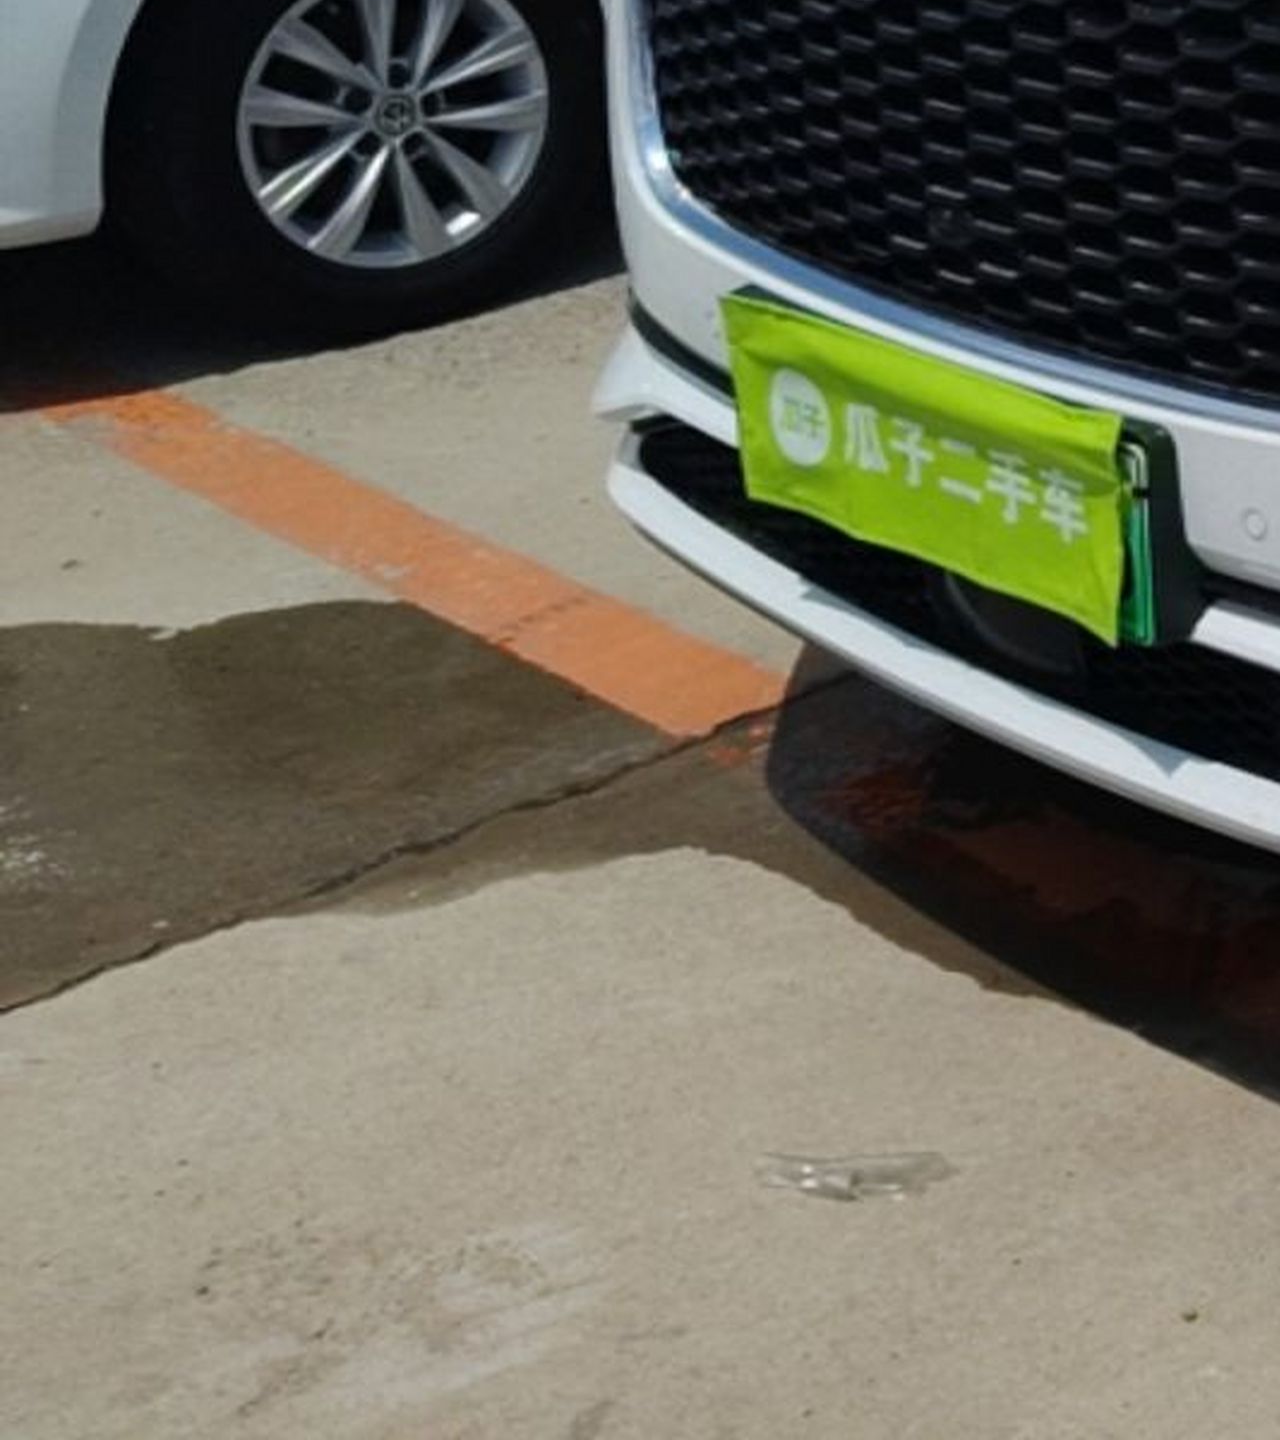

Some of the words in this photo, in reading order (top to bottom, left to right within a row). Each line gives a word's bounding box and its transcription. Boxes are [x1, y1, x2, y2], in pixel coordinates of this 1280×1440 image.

[843, 402, 1088, 544] 瓜子二手车
